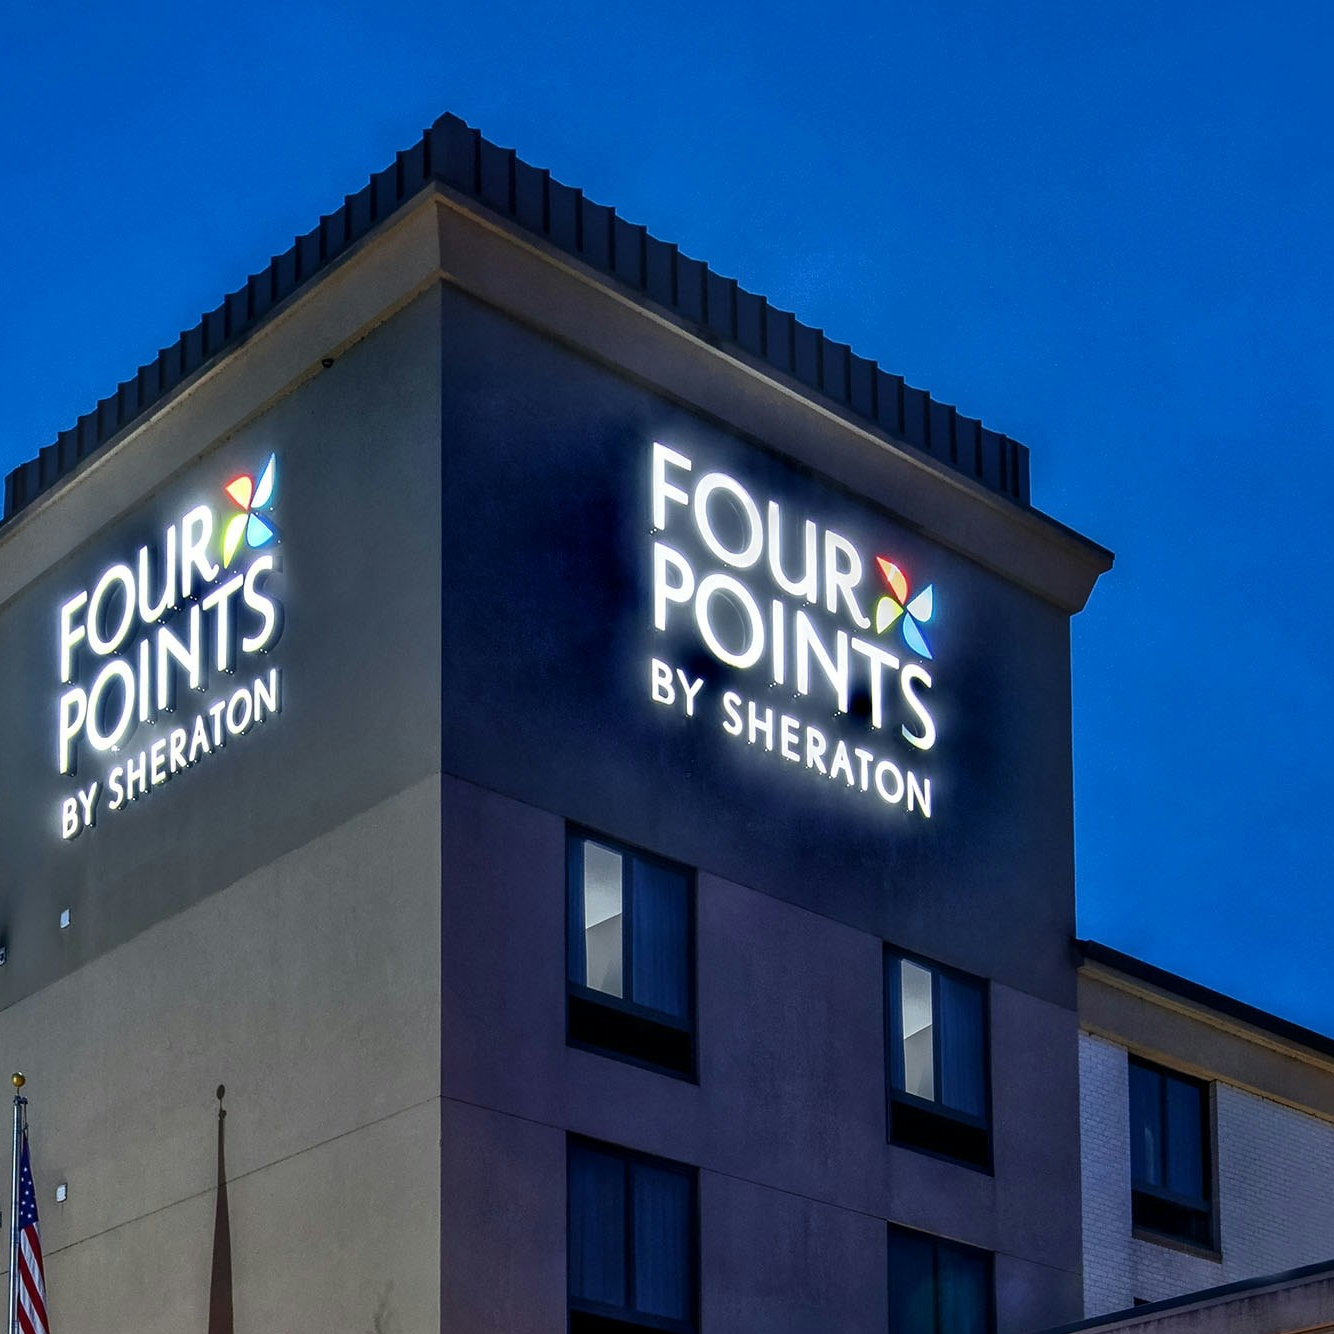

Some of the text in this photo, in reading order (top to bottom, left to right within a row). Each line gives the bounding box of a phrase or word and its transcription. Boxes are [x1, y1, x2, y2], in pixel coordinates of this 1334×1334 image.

[60, 504, 220, 684] FOUR
[652, 441, 872, 630] FOUR
[59, 555, 276, 775] POINTS
[651, 657, 932, 819] BY SHERATON
[653, 541, 937, 751] POINTS
[61, 668, 277, 840] BY SHERATON
